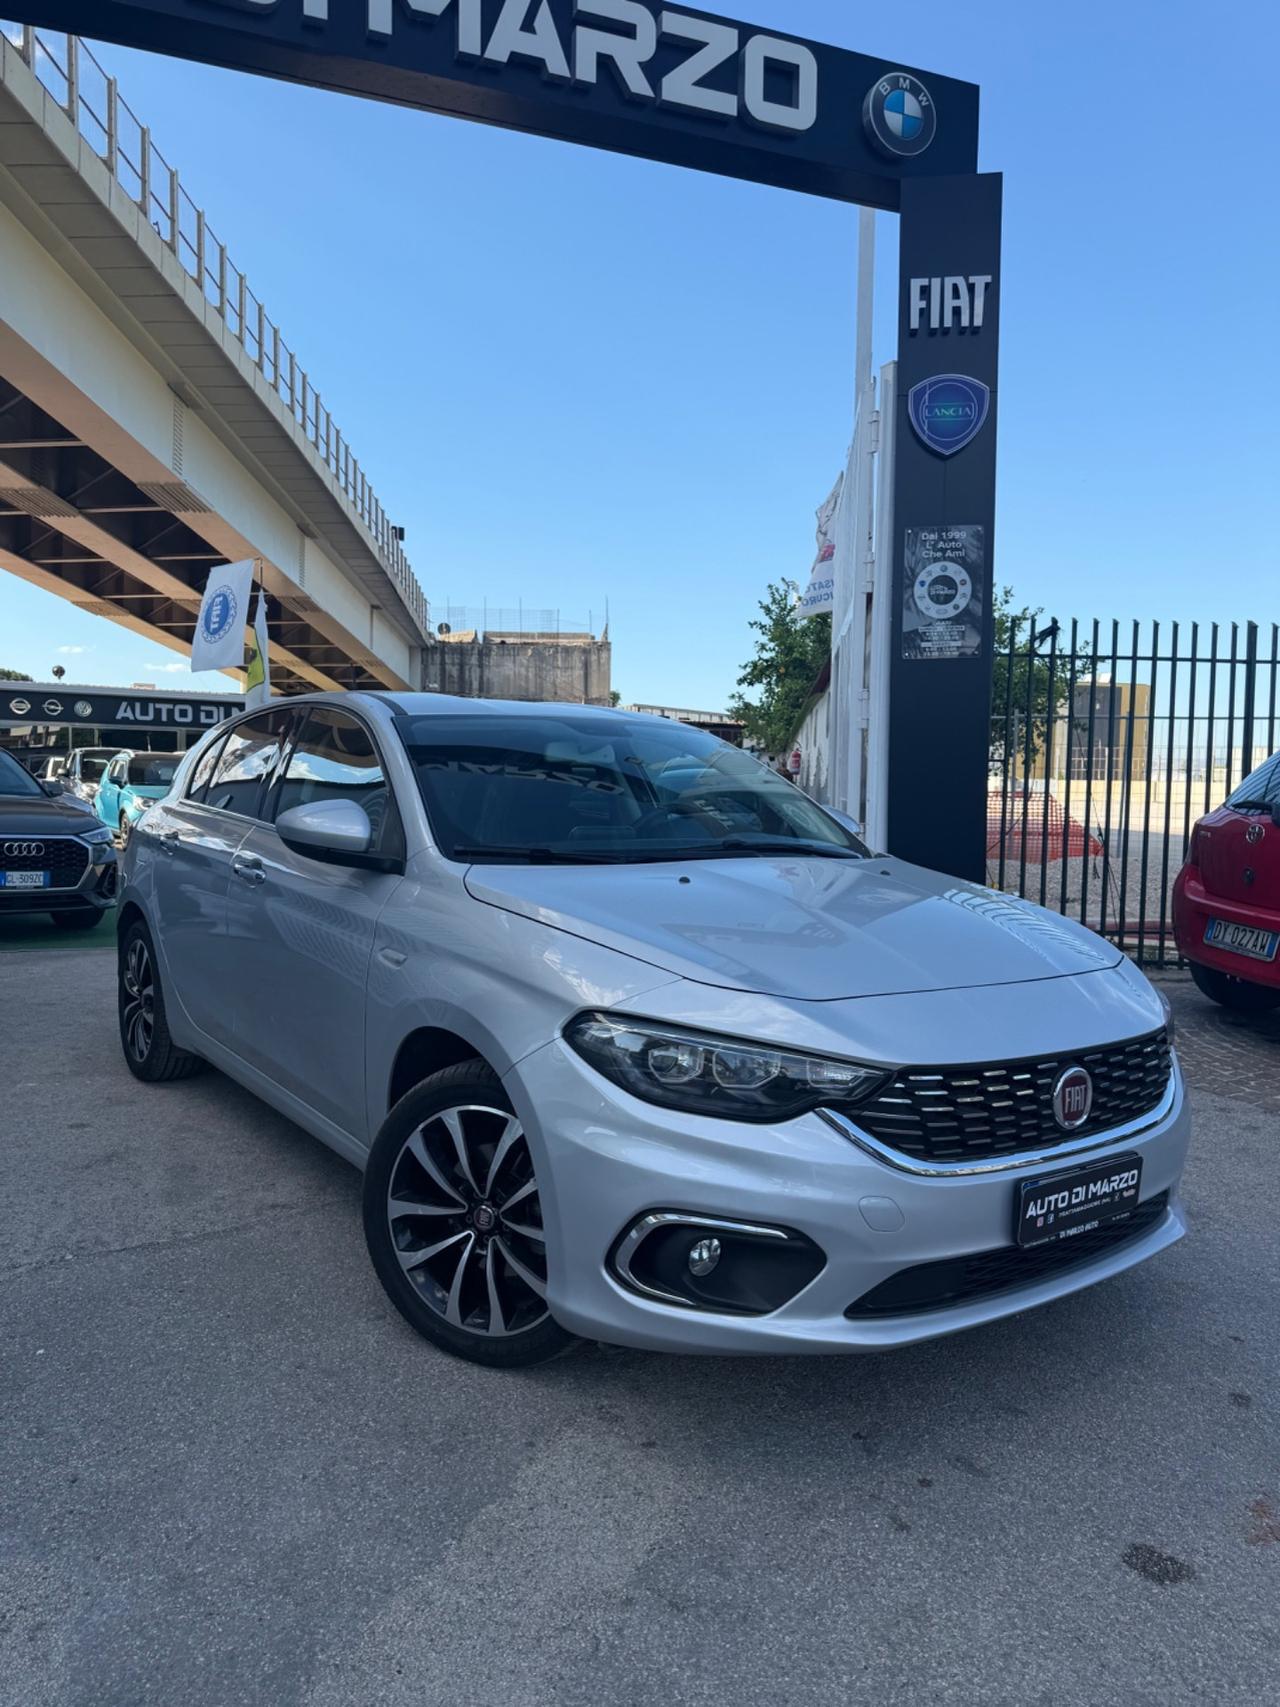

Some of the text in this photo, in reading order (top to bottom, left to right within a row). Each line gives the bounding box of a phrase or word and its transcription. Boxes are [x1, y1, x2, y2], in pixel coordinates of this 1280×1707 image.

[879, 77, 929, 106] BMW
[909, 275, 992, 330] FIAT
[925, 407, 972, 417] LANCIA
[921, 530, 967, 541] Dal 1999
[938, 540, 962, 549] Auto
[922, 548, 966, 558] Che Ami
[115, 701, 194, 723] AUTO
[200, 705, 225, 724] DI
[1213, 921, 1270, 953] DY 027AW
[1065, 1084, 1086, 1113] FIAT
[1025, 1191, 1069, 1219] AUTO
[1071, 1185, 1087, 1205] DI
[1088, 1169, 1139, 1200] MARZO
